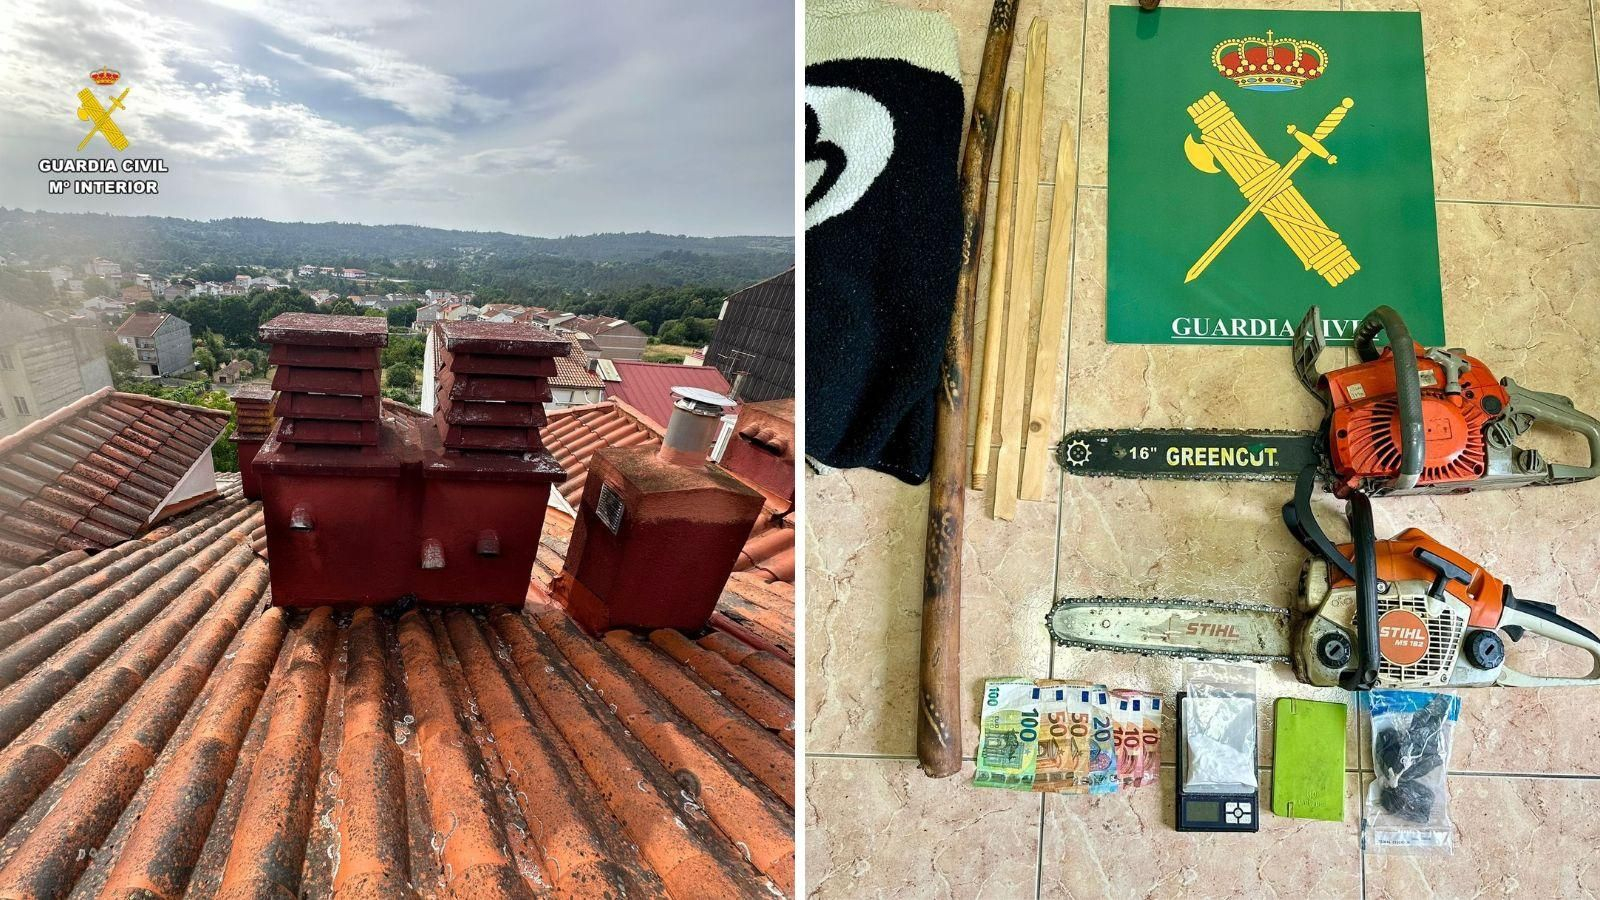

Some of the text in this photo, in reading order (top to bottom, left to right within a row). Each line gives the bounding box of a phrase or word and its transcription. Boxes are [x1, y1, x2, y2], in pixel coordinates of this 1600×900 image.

[1171, 317, 1295, 337] GUARDIA
[1129, 446, 1277, 467] 16" GREENCUT
[1185, 622, 1240, 638] STIHL
[1379, 626, 1425, 639] STIHL
[987, 687, 1000, 707] 100
[1019, 708, 1039, 742] 100
[1048, 712, 1067, 737] 50
[1070, 712, 1089, 737] 50
[1093, 716, 1111, 742] 20
[1124, 728, 1140, 747] 10
[1143, 727, 1158, 745] 10
